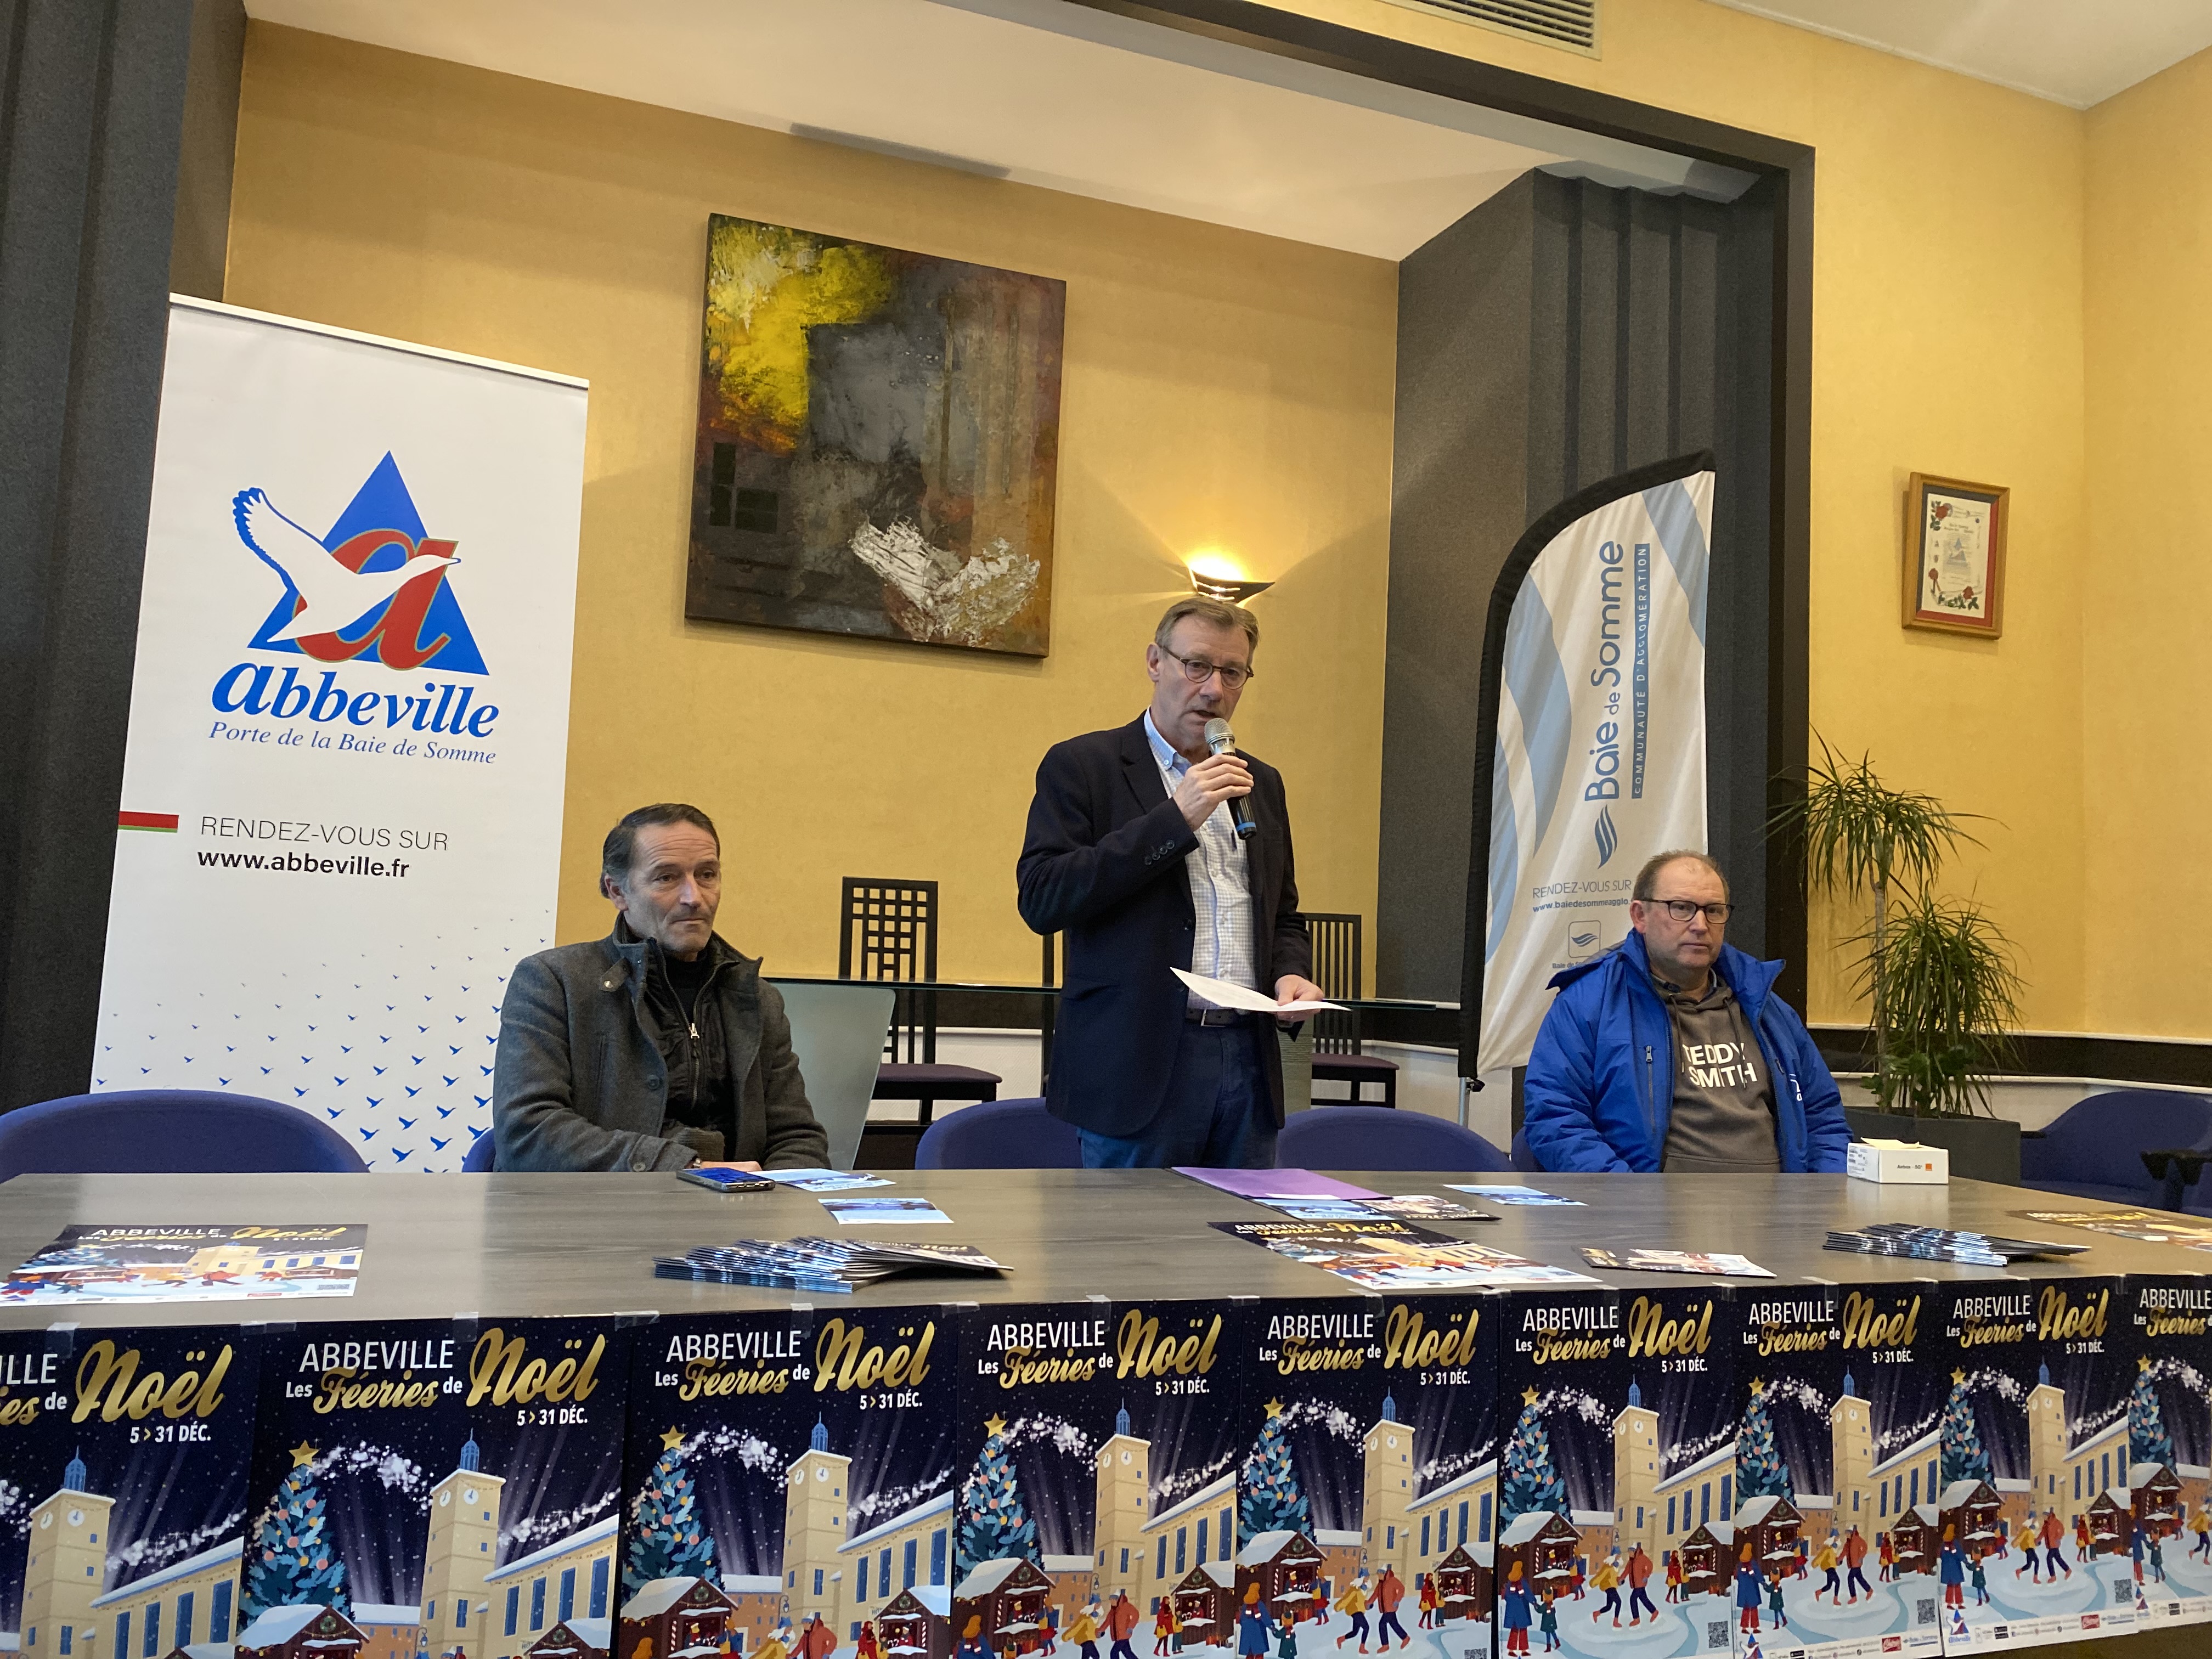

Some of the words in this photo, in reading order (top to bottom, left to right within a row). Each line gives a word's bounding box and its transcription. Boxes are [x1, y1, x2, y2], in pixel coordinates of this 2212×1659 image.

[1591, 541, 1624, 687] Somme
[212, 663, 499, 738] abbeville
[1604, 692, 1621, 715] de
[209, 722, 272, 744] Porte
[278, 729, 303, 747] de
[311, 731, 331, 749] la
[338, 733, 387, 754] Baie
[393, 740, 417, 758] de
[424, 741, 496, 765] Somme
[1634, 691, 1646, 794] COMMUNAUTÉ
[1585, 721, 1620, 801] Baie
[201, 816, 391, 848] RENDEZ-VOUS
[399, 831, 449, 851] SUR
[198, 850, 409, 878] www.abbeville.fr
[1533, 881, 1610, 899] RENDEZ-VOUS
[1613, 879, 1632, 891] SUR
[1682, 1042, 1745, 1065] TEDDY
[1689, 1062, 1757, 1088] SMITH
[1749, 1301, 1833, 1324] ABBEVILLE
[1953, 1295, 2031, 1319] ABBEVILLE
[2140, 1289, 2212, 1309] ABBEVILLE
[1267, 1314, 1373, 1339] ABBEVILLE
[1516, 1339, 1532, 1351] Les
[1533, 1328, 1610, 1364] Féeries
[1613, 1334, 1625, 1347] de
[1629, 1296, 1713, 1357] Noël
[1523, 1306, 1618, 1331] ABBEVILLE
[1743, 1332, 1757, 1344] Les
[1759, 1321, 1826, 1356] Féeries
[1830, 1327, 1840, 1340] de
[1843, 1292, 1920, 1349] Noël
[1947, 1325, 1960, 1336] Les
[1960, 1315, 2024, 1348] Féeries
[2026, 1320, 2036, 1331] de
[2039, 1286, 2108, 1340] Noël
[2134, 1314, 2146, 1324] Les
[666, 1330, 801, 1362] ABBEVILLE
[978, 1359, 998, 1374] Les
[1000, 1346, 1094, 1389] Féeries
[1099, 1352, 1113, 1368] de
[1117, 1310, 1221, 1379] Noël
[987, 1321, 1104, 1351] ABBEVILLE
[1260, 1347, 1277, 1361] Les
[1278, 1336, 1363, 1374] Féeries
[1367, 1344, 1381, 1358] de
[1384, 1305, 1479, 1369] Noël
[2067, 1343, 2070, 1353] 5
[2078, 1342, 2086, 1353] 31
[2089, 1339, 2104, 1353] DÉC.
[299, 1340, 454, 1372] ABBEVILLE
[656, 1372, 678, 1386] Les
[680, 1357, 788, 1400] Féeries
[793, 1364, 810, 1380] de
[814, 1318, 934, 1391] Noël
[1662, 1361, 1667, 1373] 5
[1676, 1359, 1685, 1372] 31
[1689, 1356, 1707, 1372] DÉC.
[1873, 1352, 1877, 1363] 5
[1885, 1351, 1894, 1363] 31
[1897, 1348, 1914, 1362] DÉC.
[45, 1392, 67, 1409] de
[72, 1340, 232, 1422] Noël
[286, 1382, 312, 1397] Les
[314, 1368, 437, 1413] Féeries
[443, 1376, 462, 1393] de
[467, 1328, 605, 1406] Noël
[1420, 1373, 1426, 1385] 5
[1436, 1372, 1446, 1385] 31
[1451, 1368, 1470, 1384] DÉC.
[860, 1395, 867, 1409] 5
[879, 1393, 893, 1409] 31
[898, 1389, 922, 1407] DÉC.
[1156, 1382, 1161, 1395] 5
[1172, 1380, 1183, 1395] 31
[1188, 1376, 1209, 1393] DÉC.
[517, 1410, 525, 1426] 5
[539, 1409, 555, 1425] 31
[560, 1404, 588, 1424] DÉC.
[130, 1427, 139, 1443] 5
[155, 1426, 173, 1442] 31
[179, 1421, 211, 1441] DÉC.
